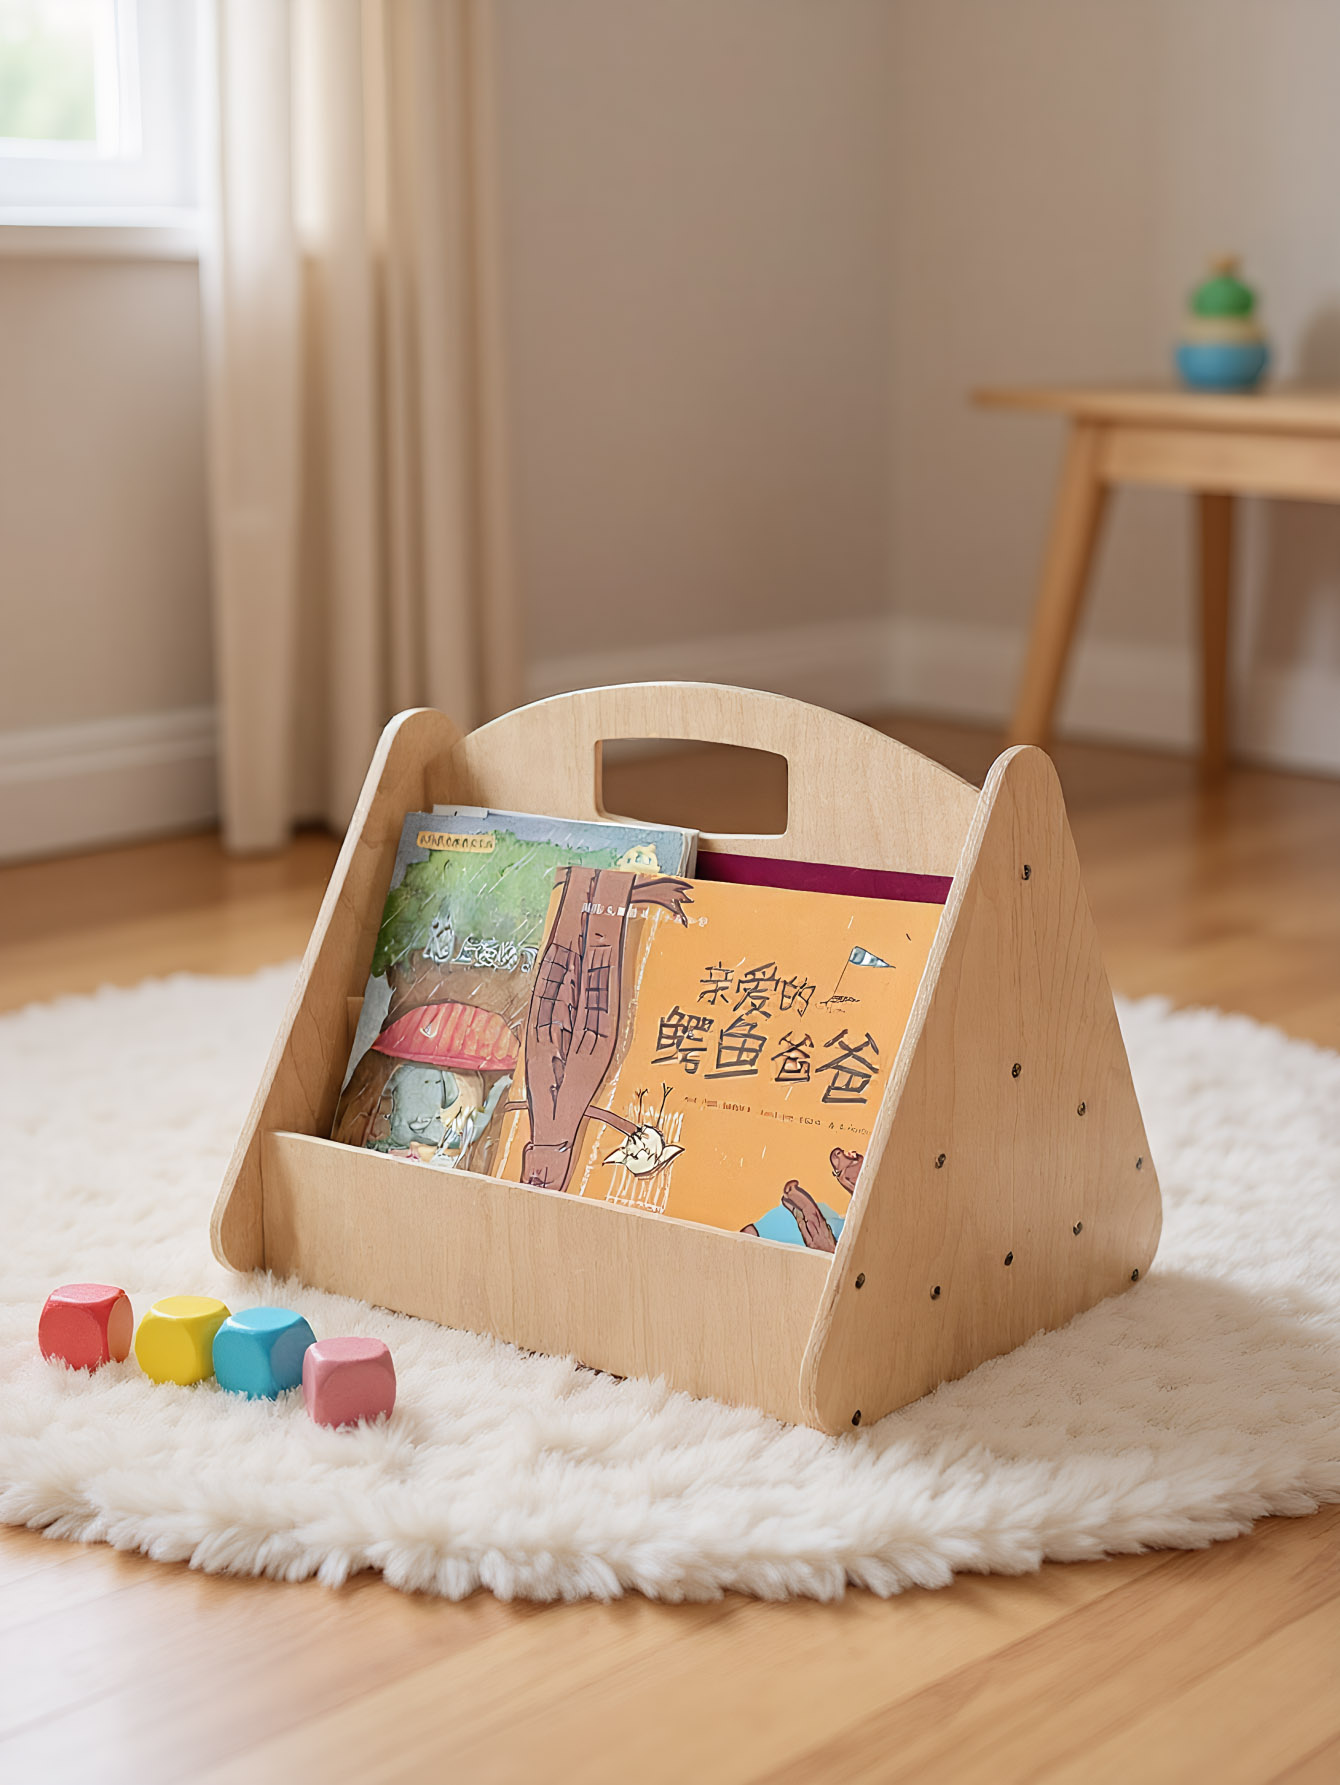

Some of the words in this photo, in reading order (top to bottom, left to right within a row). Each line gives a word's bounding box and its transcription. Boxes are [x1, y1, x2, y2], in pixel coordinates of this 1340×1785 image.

[697, 961, 816, 1018] 亲爱的
[651, 1005, 880, 1104] 鳄鱼爸爸
